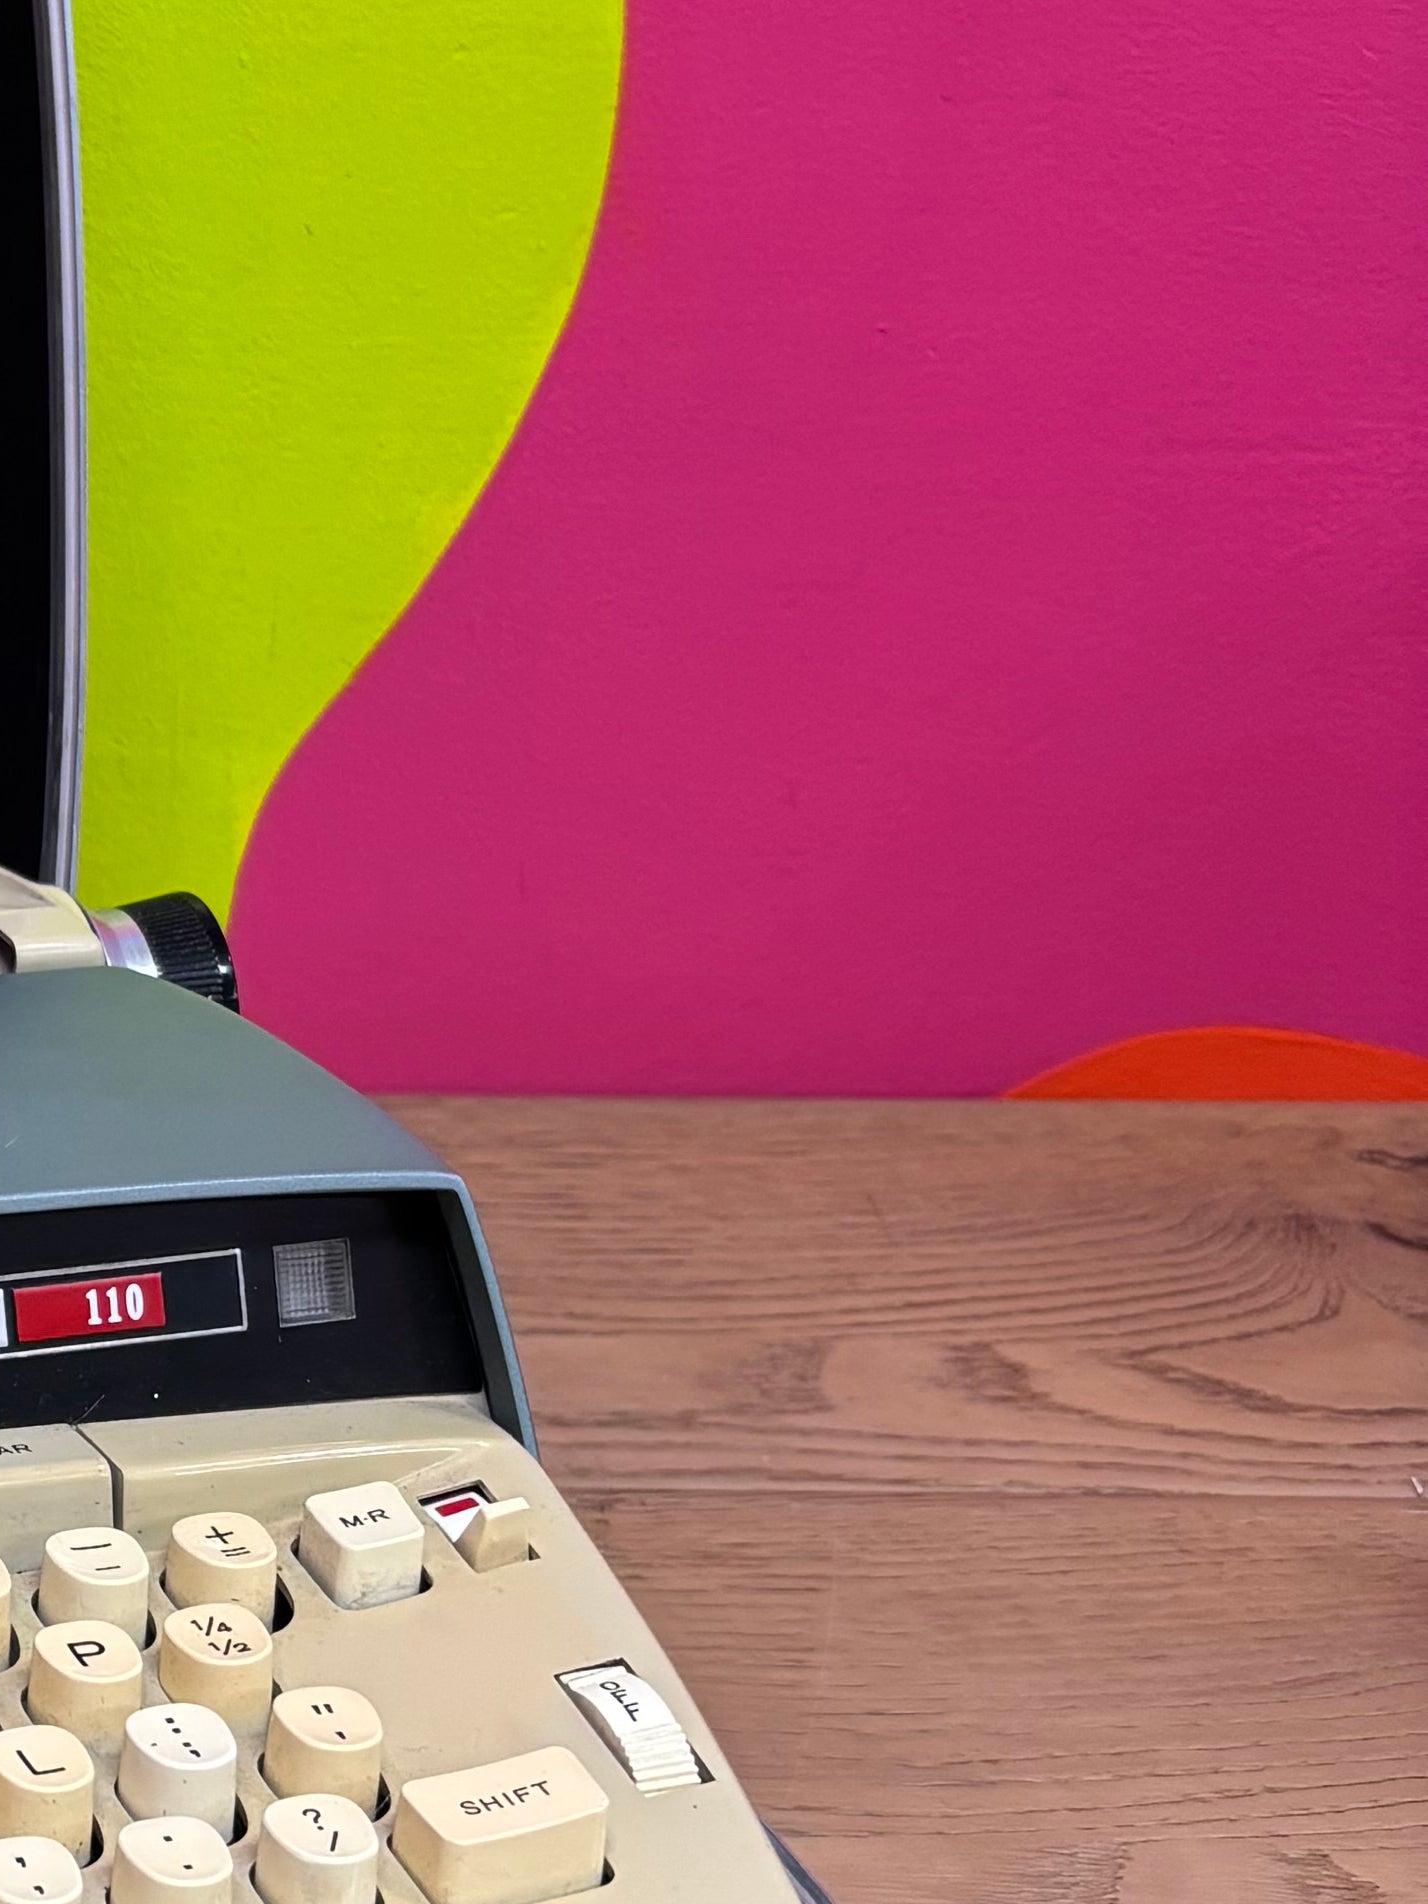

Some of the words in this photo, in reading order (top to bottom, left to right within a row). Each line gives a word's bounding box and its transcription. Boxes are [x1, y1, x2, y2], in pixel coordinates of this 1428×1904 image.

[84, 1282, 145, 1327] 110
[204, 1525, 234, 1545] +
[220, 1546, 251, 1558] =
[66, 1640, 106, 1668] P
[599, 1680, 640, 1723] OFF
[15, 1749, 66, 1776] L
[459, 1780, 550, 1816] SHIFT
[302, 1808, 325, 1831] ?
